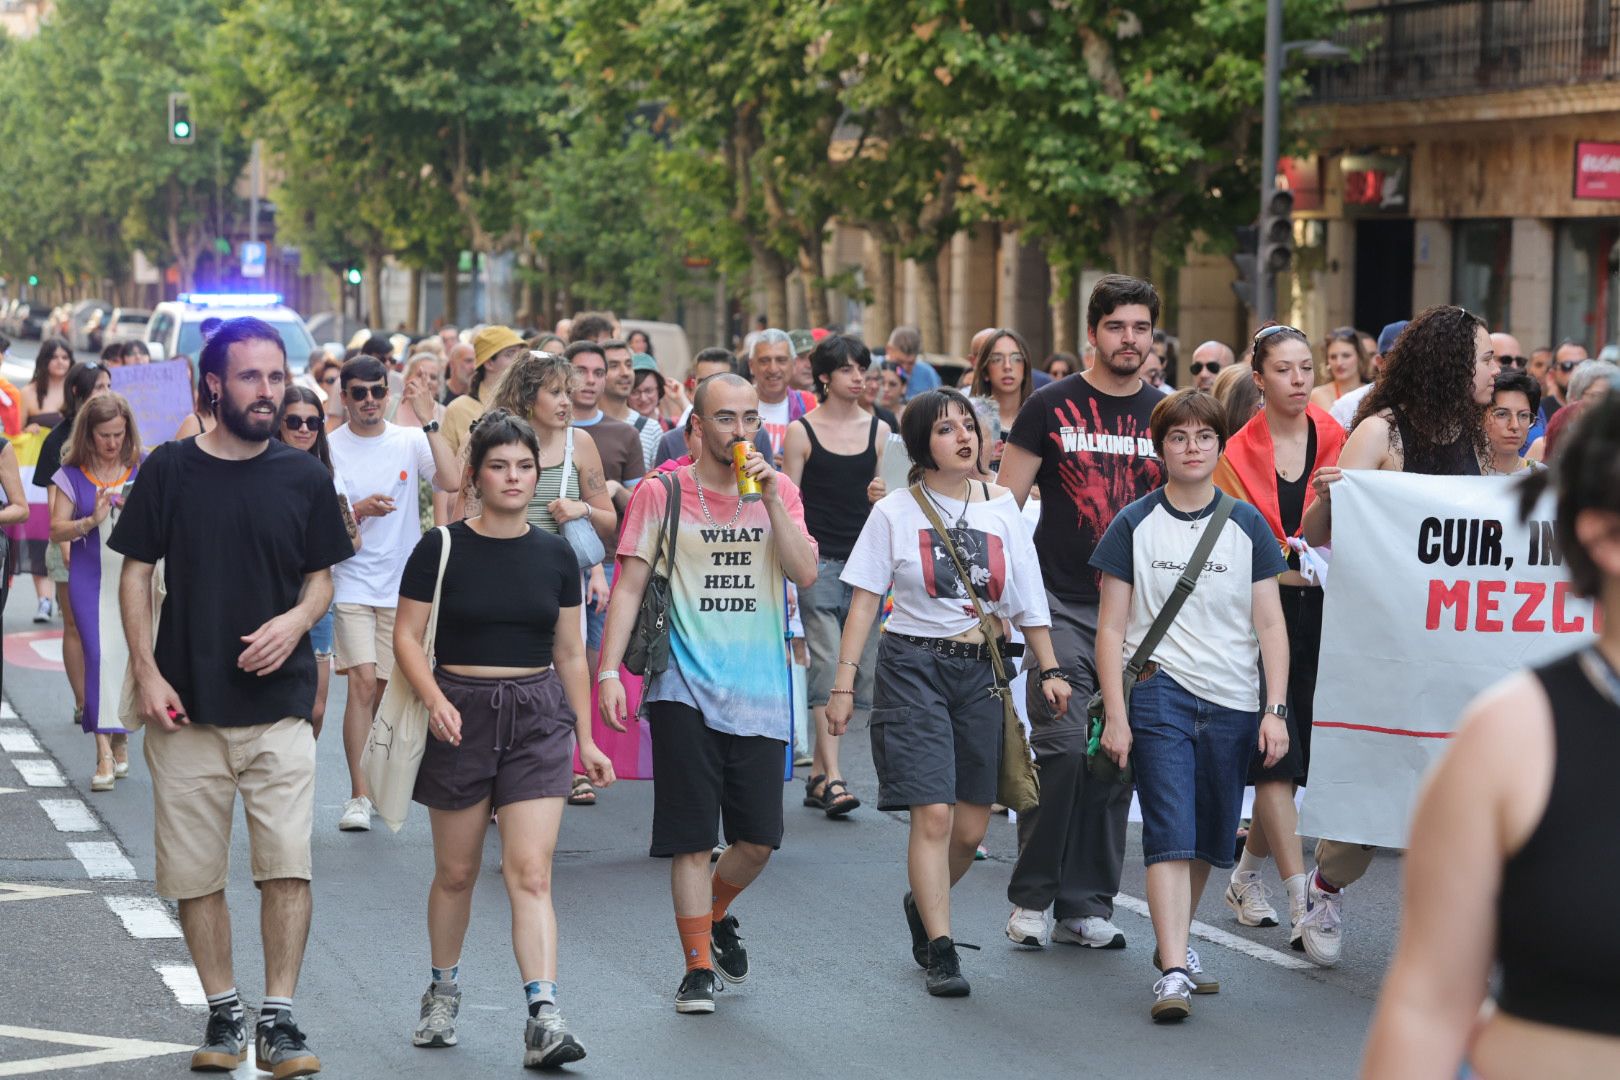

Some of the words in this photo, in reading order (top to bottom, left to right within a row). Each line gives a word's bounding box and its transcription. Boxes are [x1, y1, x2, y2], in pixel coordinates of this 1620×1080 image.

[1061, 433, 1135, 455] WALKING
[700, 527, 763, 543] WHAT
[1418, 516, 1514, 571] CUIR,
[1528, 520, 1563, 566] IN
[711, 551, 752, 566] THE
[704, 574, 755, 589] HELL
[699, 597, 756, 612] DUDE
[1426, 579, 1603, 634] MEZC
